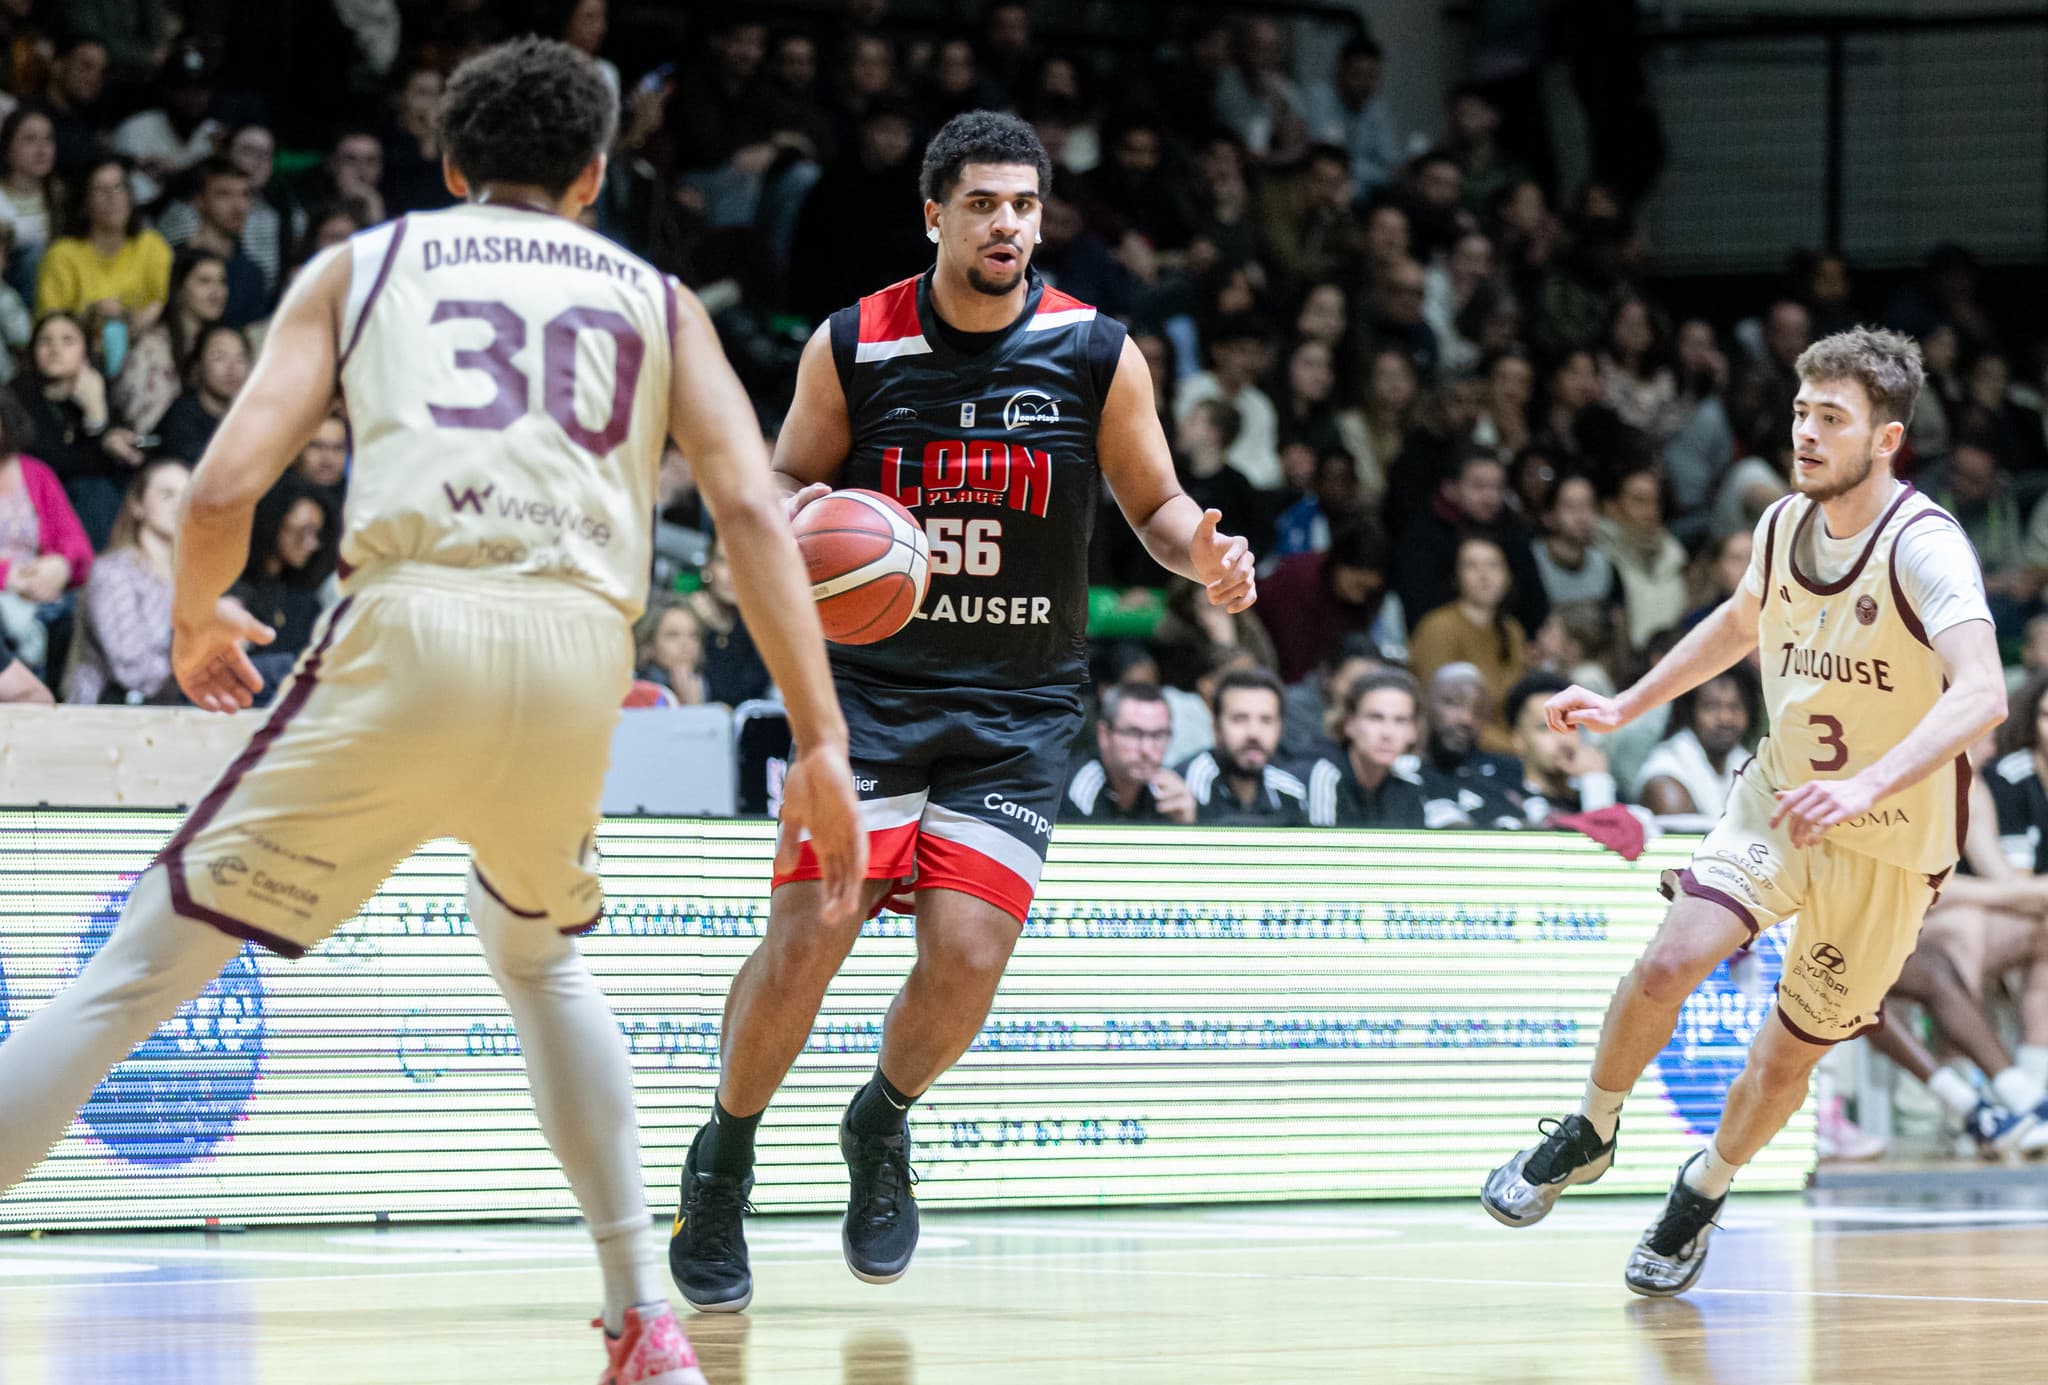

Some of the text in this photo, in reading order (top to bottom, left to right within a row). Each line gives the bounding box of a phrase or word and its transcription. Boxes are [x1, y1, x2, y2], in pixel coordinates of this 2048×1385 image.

[426, 299, 646, 459] 30
[881, 440, 1051, 518] LOON
[925, 490, 1004, 506] PLAGE
[498, 496, 612, 548] wewse
[925, 518, 1002, 577] 56
[1808, 714, 1848, 771] 3
